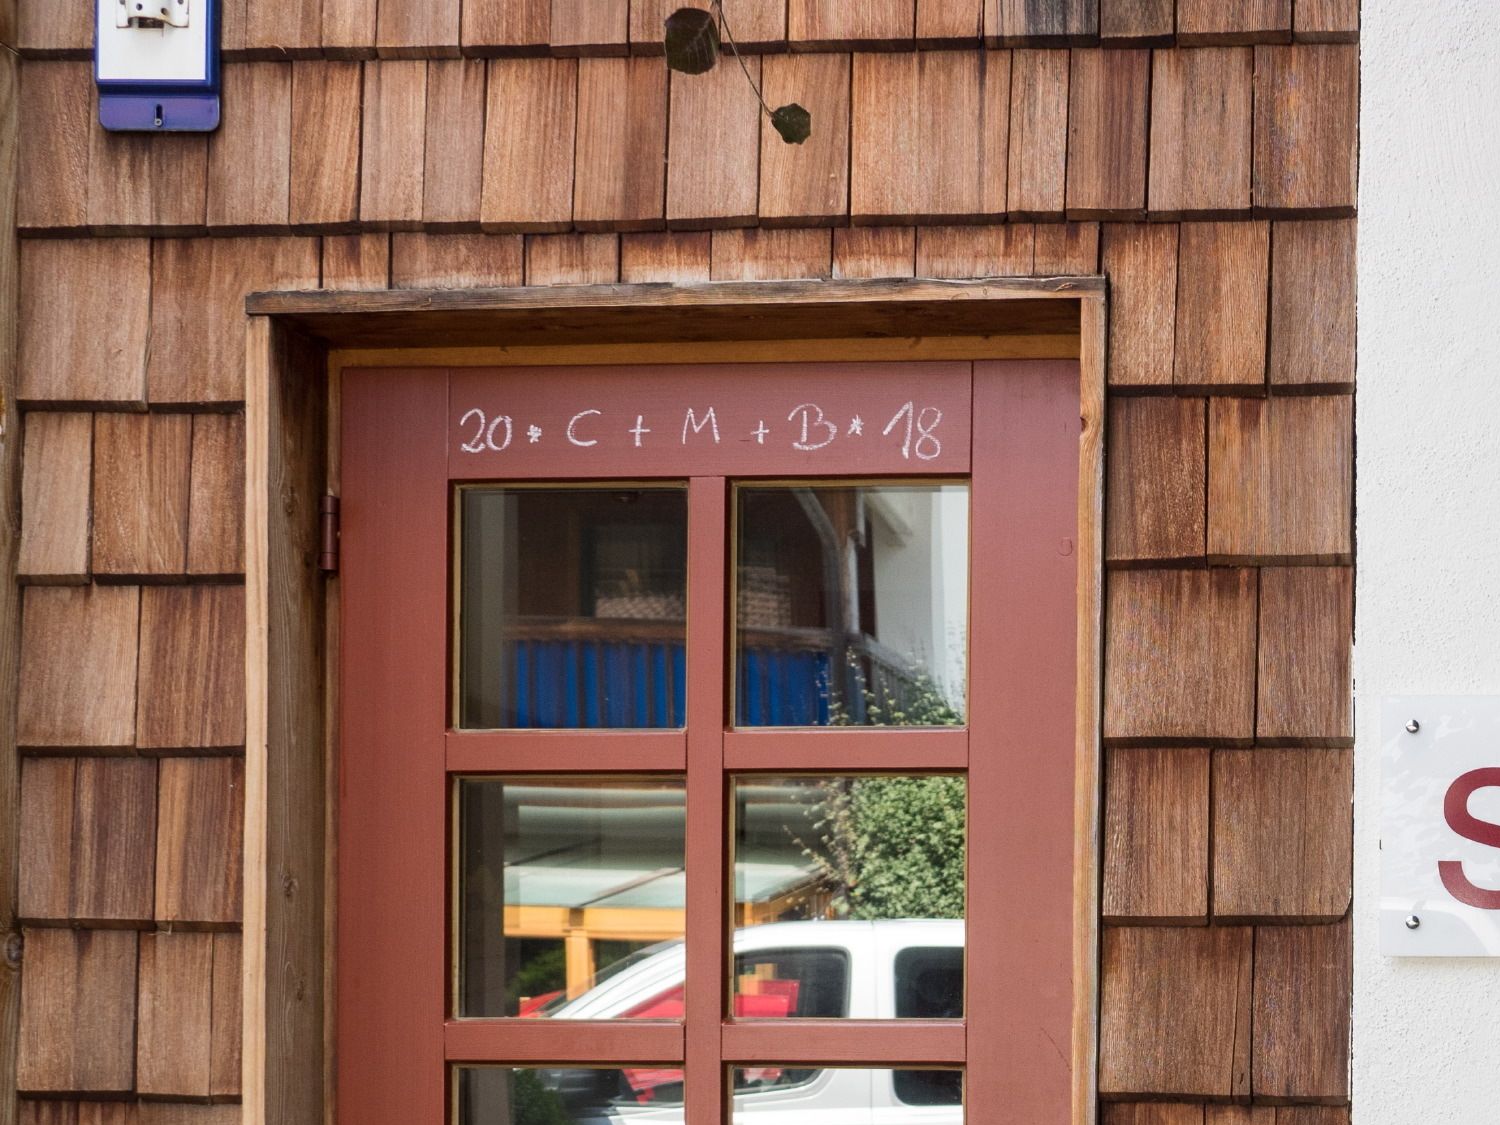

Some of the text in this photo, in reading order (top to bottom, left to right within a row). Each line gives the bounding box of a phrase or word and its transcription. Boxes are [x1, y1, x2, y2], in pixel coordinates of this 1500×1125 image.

[566, 409, 602, 447] C
[681, 406, 721, 445] M
[882, 400, 943, 461] 18
